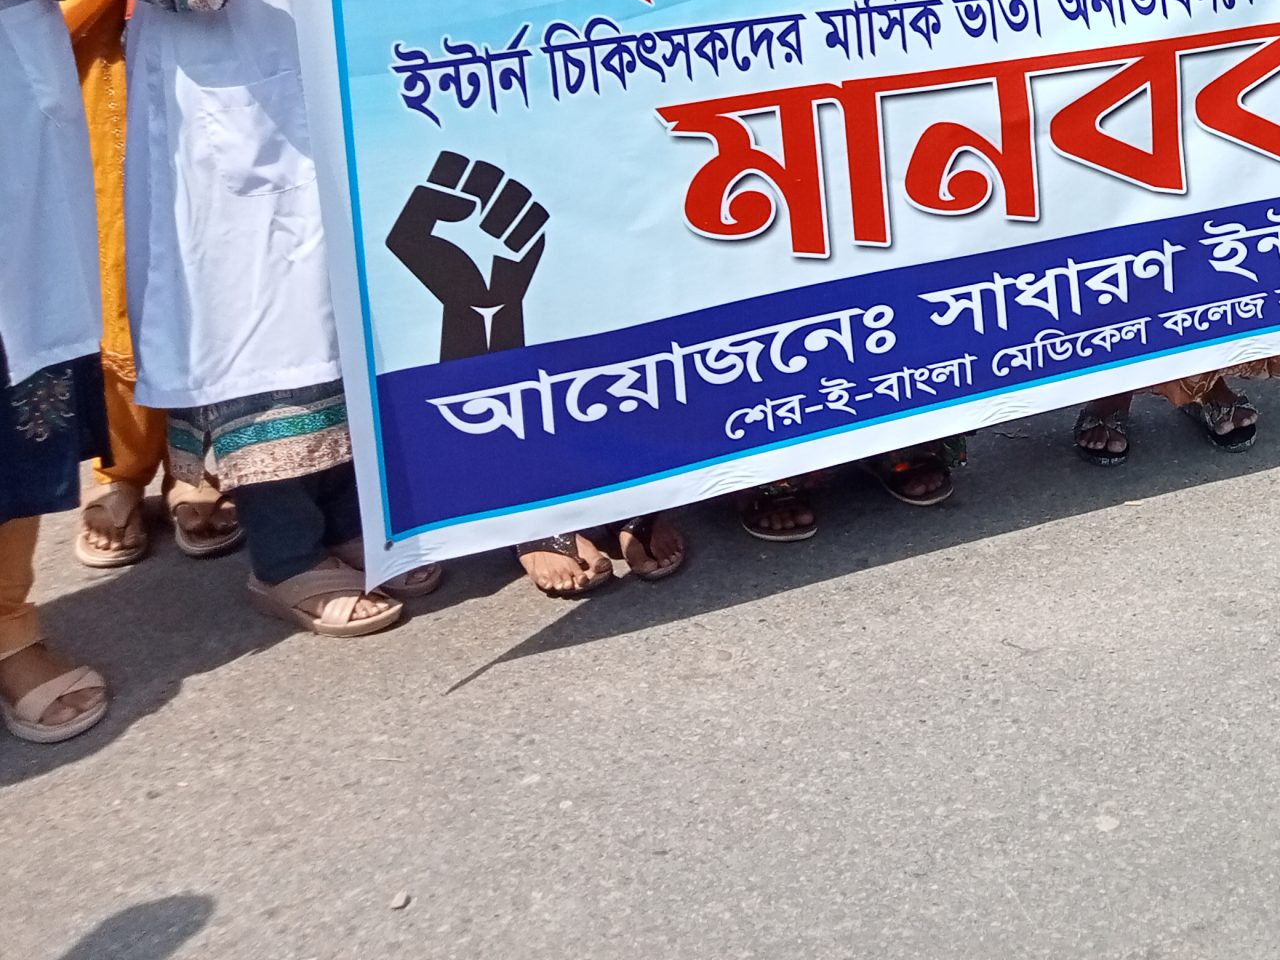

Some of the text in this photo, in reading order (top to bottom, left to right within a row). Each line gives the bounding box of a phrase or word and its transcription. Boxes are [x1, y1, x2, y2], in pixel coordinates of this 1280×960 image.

[392, 24, 530, 127] ইন্টার্ন
[541, 14, 804, 100] চিকিৎসকদের
[918, 239, 1186, 334] সাধারণ
[726, 353, 978, 440] শের-ই-বাংলা
[991, 316, 1150, 377] মেডিকেল
[1159, 292, 1268, 337] কলেজ
